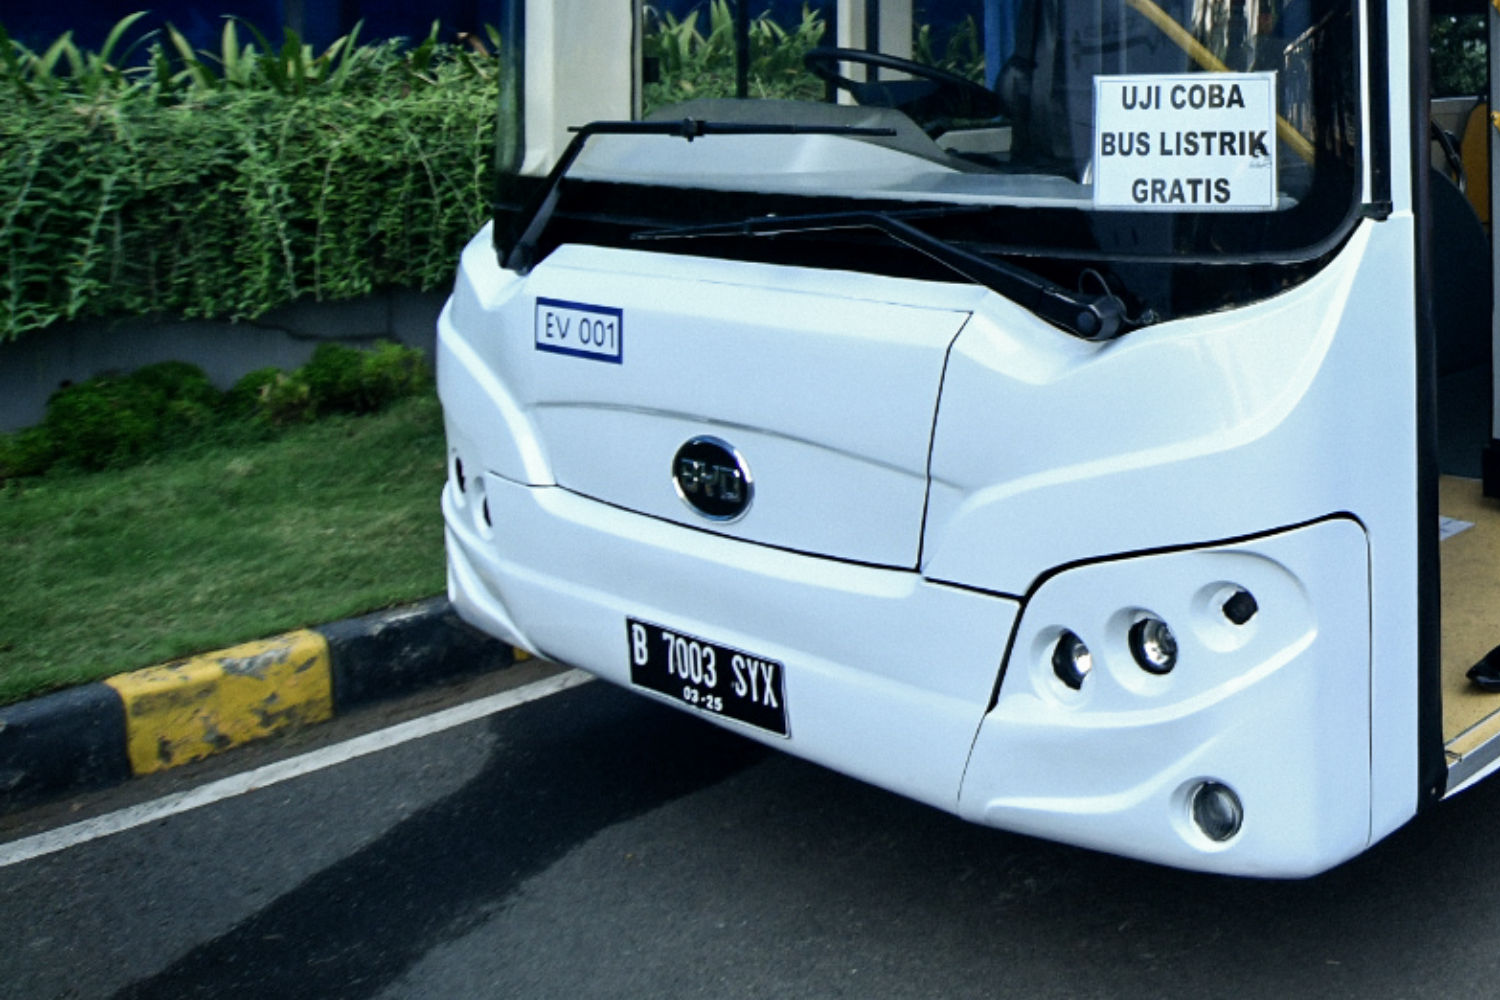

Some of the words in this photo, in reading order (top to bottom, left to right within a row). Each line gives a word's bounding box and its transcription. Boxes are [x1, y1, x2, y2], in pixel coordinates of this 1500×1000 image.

[1121, 85, 1161, 110] UJI
[1170, 84, 1245, 110] COBA
[1101, 131, 1150, 156] BUS
[1160, 130, 1270, 157] LISTRIK
[1131, 178, 1231, 204] GRATIS
[546, 312, 570, 340] EV
[579, 317, 615, 349] 001
[631, 623, 648, 666] B
[662, 632, 717, 689] 7003
[732, 654, 779, 709] SYX
